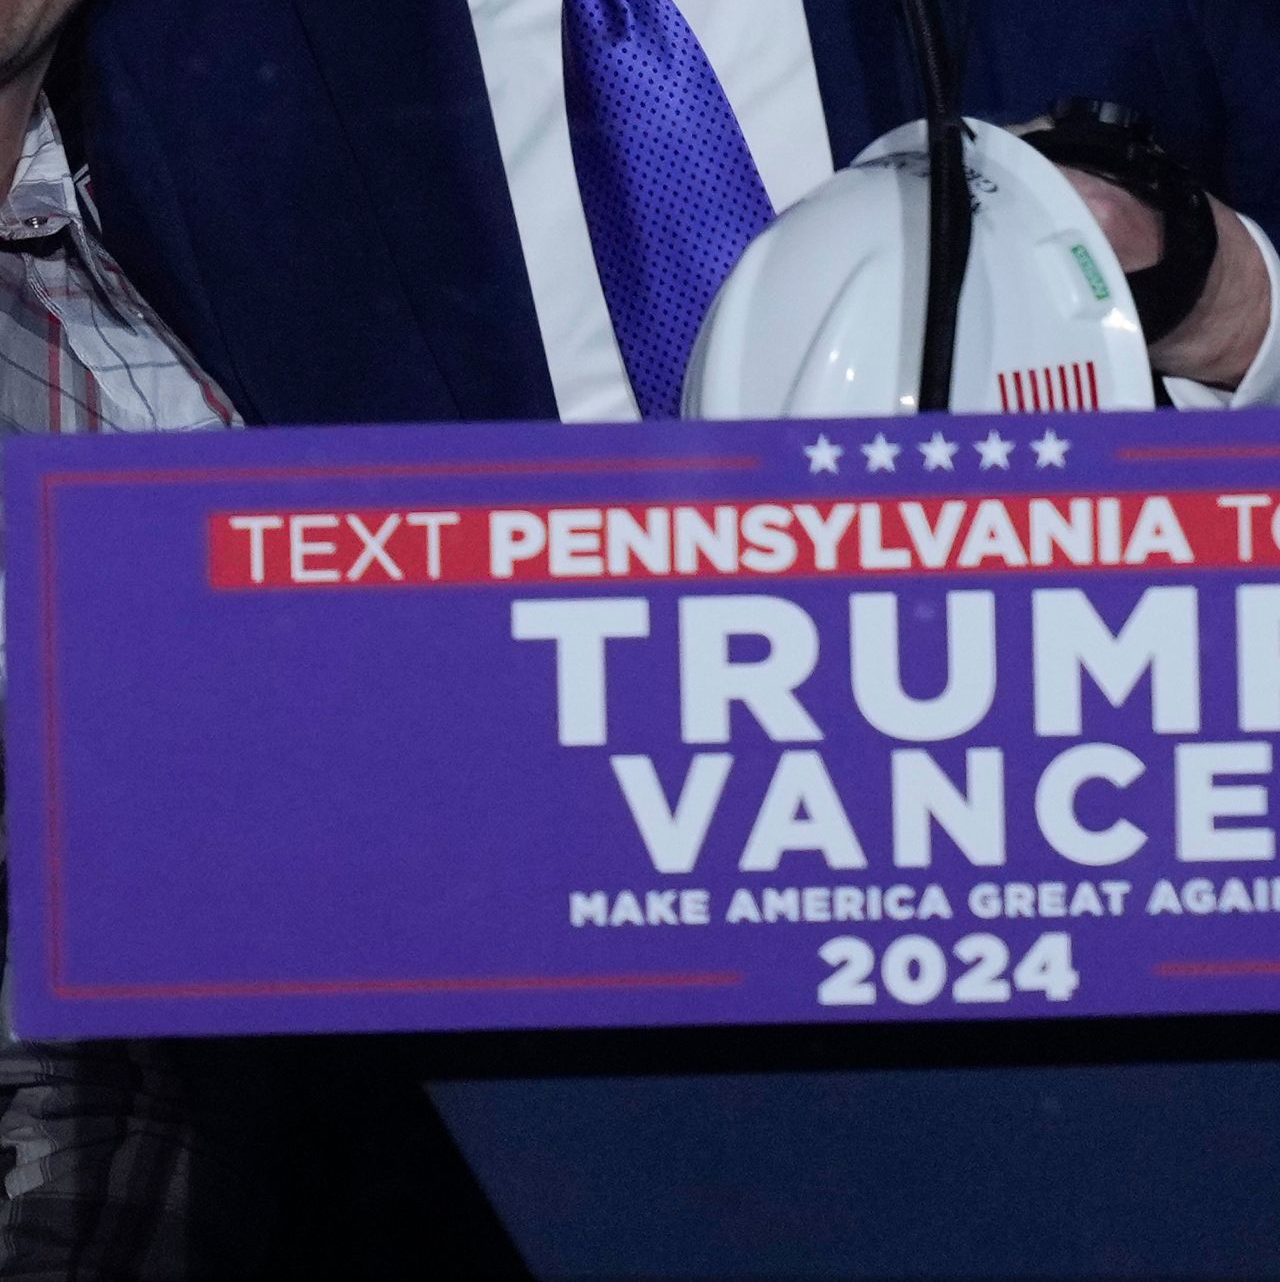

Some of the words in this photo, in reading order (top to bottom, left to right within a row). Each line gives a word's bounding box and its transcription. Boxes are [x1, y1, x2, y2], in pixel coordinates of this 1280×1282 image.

[229, 511, 460, 584] TEXT
[489, 497, 1195, 579] PENNSYLVANIA
[611, 741, 1276, 874] VANCE
[570, 889, 710, 927] MAKE
[725, 884, 953, 924] AMERICA
[967, 880, 1131, 920] GREAT
[818, 932, 1079, 1006] 2024
